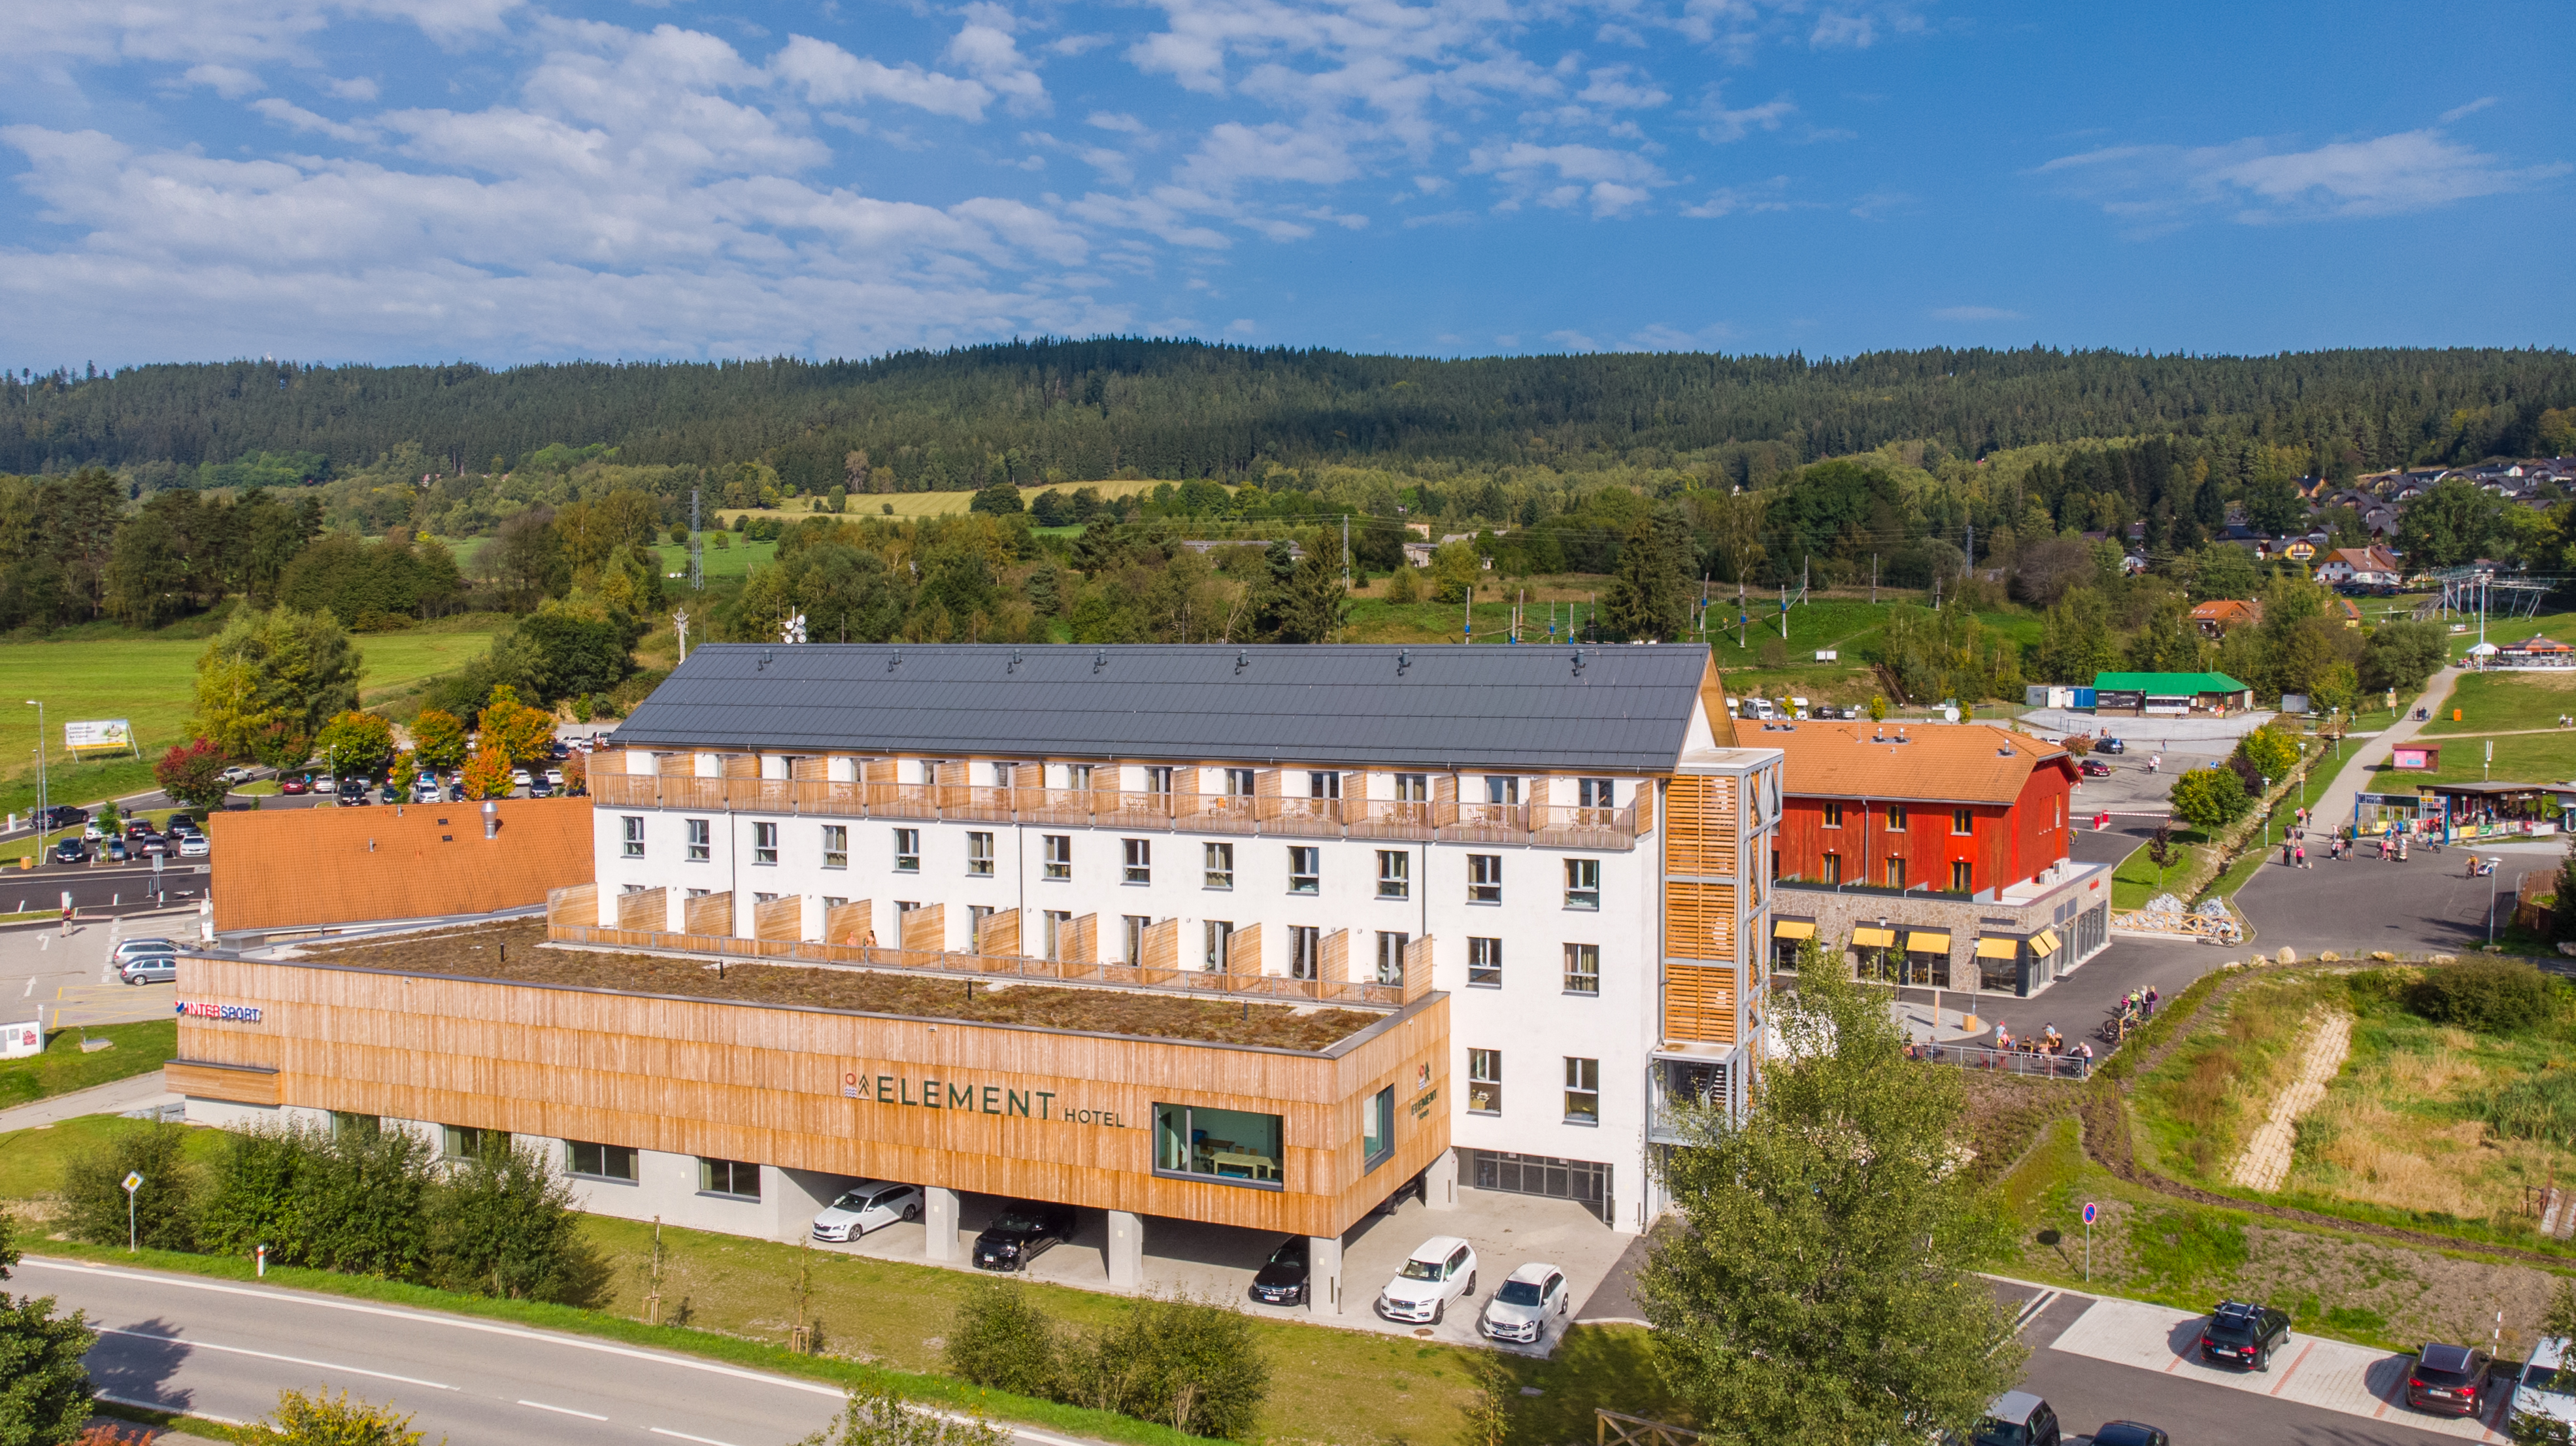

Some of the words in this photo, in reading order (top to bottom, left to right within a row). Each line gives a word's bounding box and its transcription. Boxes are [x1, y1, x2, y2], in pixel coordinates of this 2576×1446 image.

[186, 1001, 259, 1021] INTERSPORT
[877, 1075, 1056, 1120] ELEMENT
[1065, 1108, 1125, 1128] HOTEL
